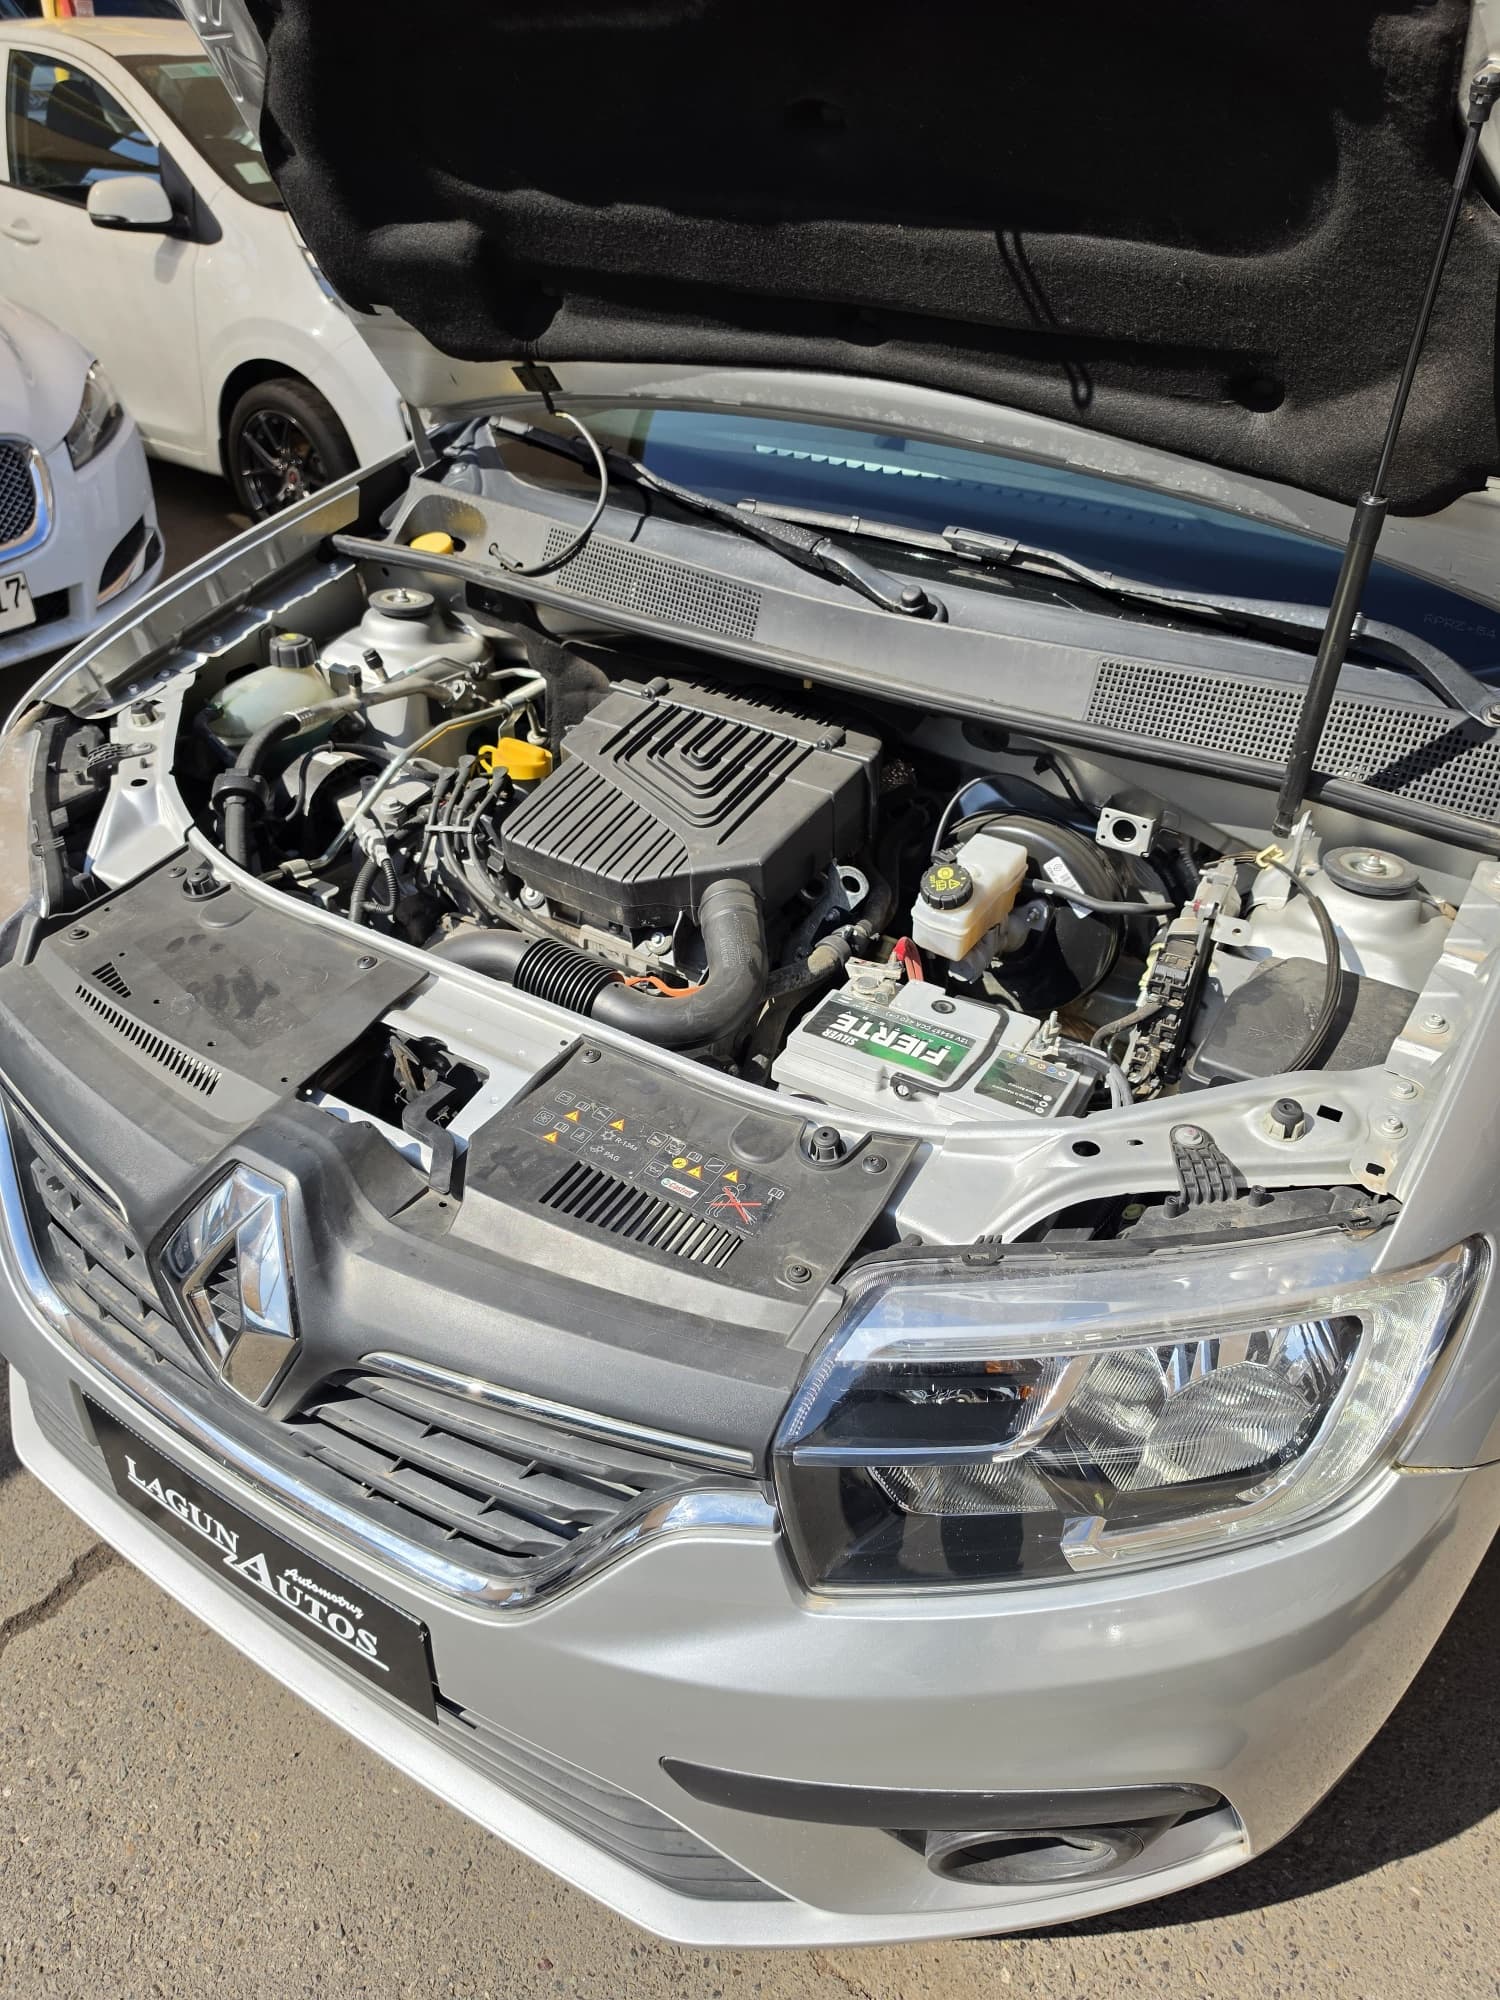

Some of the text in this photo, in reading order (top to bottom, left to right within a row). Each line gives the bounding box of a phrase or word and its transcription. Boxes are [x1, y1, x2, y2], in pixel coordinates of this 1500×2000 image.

[822, 1027, 859, 1047] SILVER
[829, 1012, 951, 1067] FIERTE
[955, 1035, 969, 1045] 12V
[603, 1151, 620, 1162] PAG
